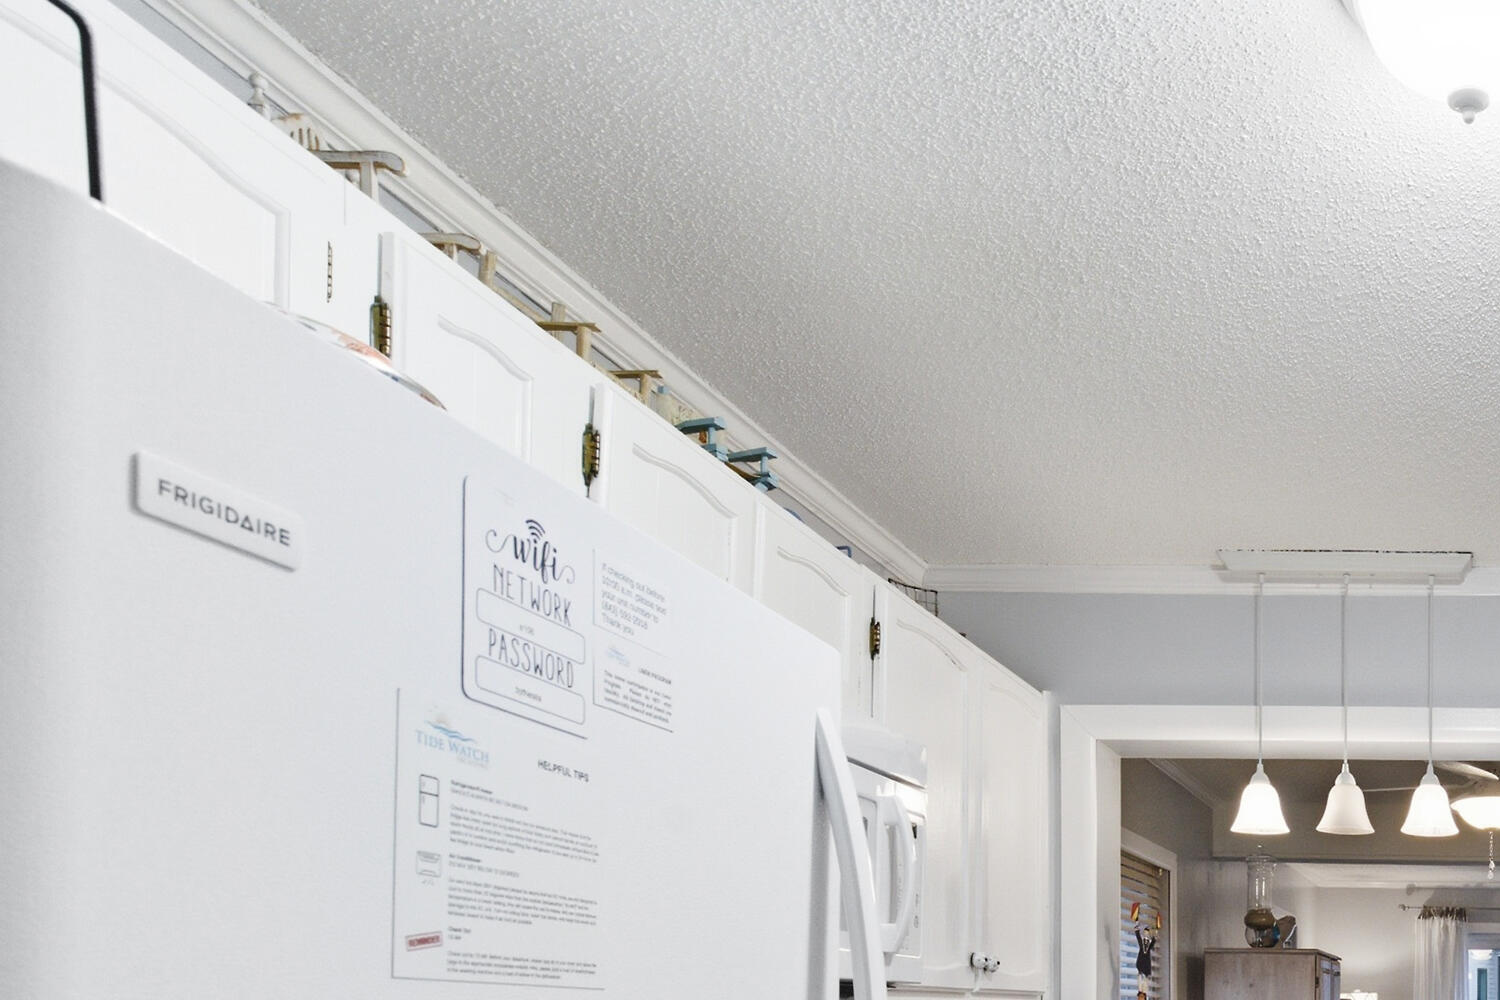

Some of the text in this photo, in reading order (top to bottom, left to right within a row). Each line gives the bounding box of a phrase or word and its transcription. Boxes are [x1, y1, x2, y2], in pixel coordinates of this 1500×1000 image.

[158, 477, 291, 547] FRIGIDAIRE
[485, 529, 576, 585] wifi
[492, 563, 572, 628] NETWORK
[488, 627, 575, 688] PASSWORD
[415, 729, 446, 751] TIDE
[448, 738, 490, 764] WATCH
[537, 759, 590, 783] HELPFUL TIPS
